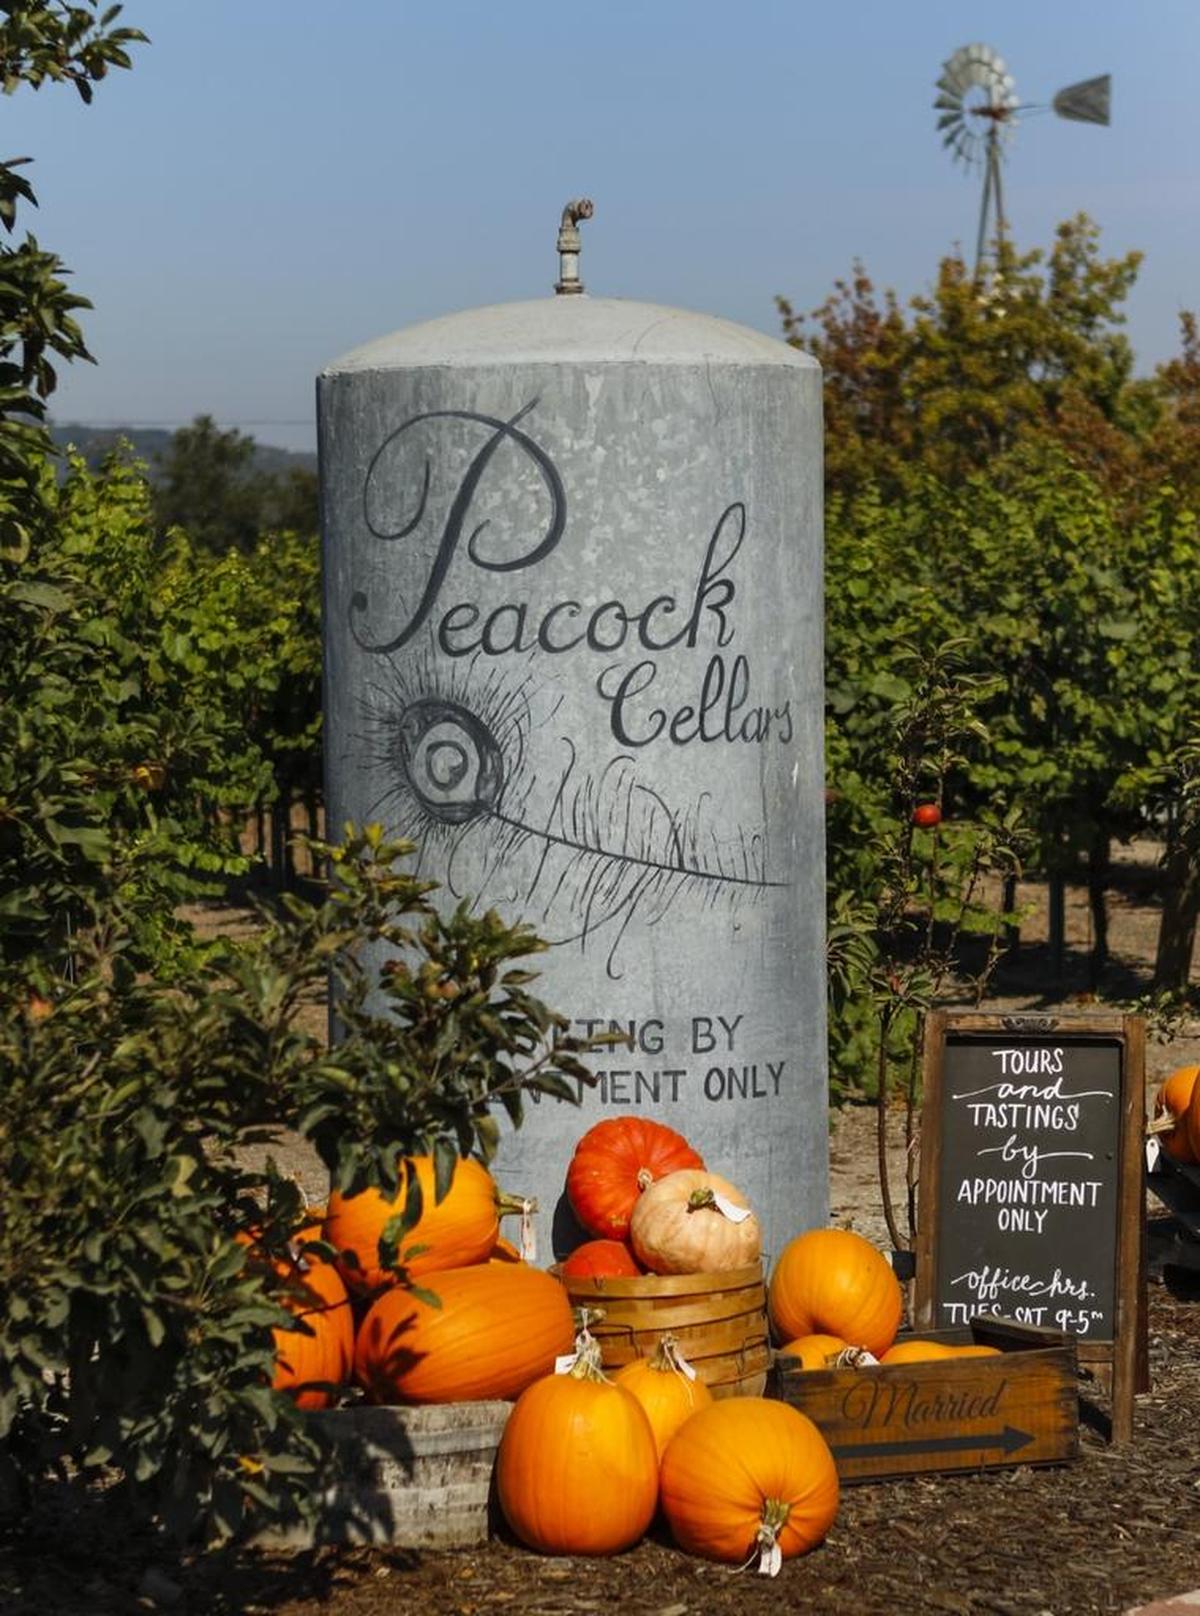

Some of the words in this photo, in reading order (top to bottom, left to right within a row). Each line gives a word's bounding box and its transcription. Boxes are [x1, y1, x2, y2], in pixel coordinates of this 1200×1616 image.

[348, 398, 746, 657] Peacock
[596, 654, 793, 747] Cellars
[692, 1015, 744, 1054] BY
[992, 1048, 1064, 1075] TOURS
[703, 1062, 785, 1101] ONLY
[967, 1102, 1080, 1130] TASTINGS
[957, 1178, 1103, 1207] APPOINTMENT
[998, 1207, 1048, 1234] ONLY
[950, 1265, 1044, 1300] office
[1029, 1268, 1096, 1300] hrs.
[841, 1378, 1008, 1431] Married
